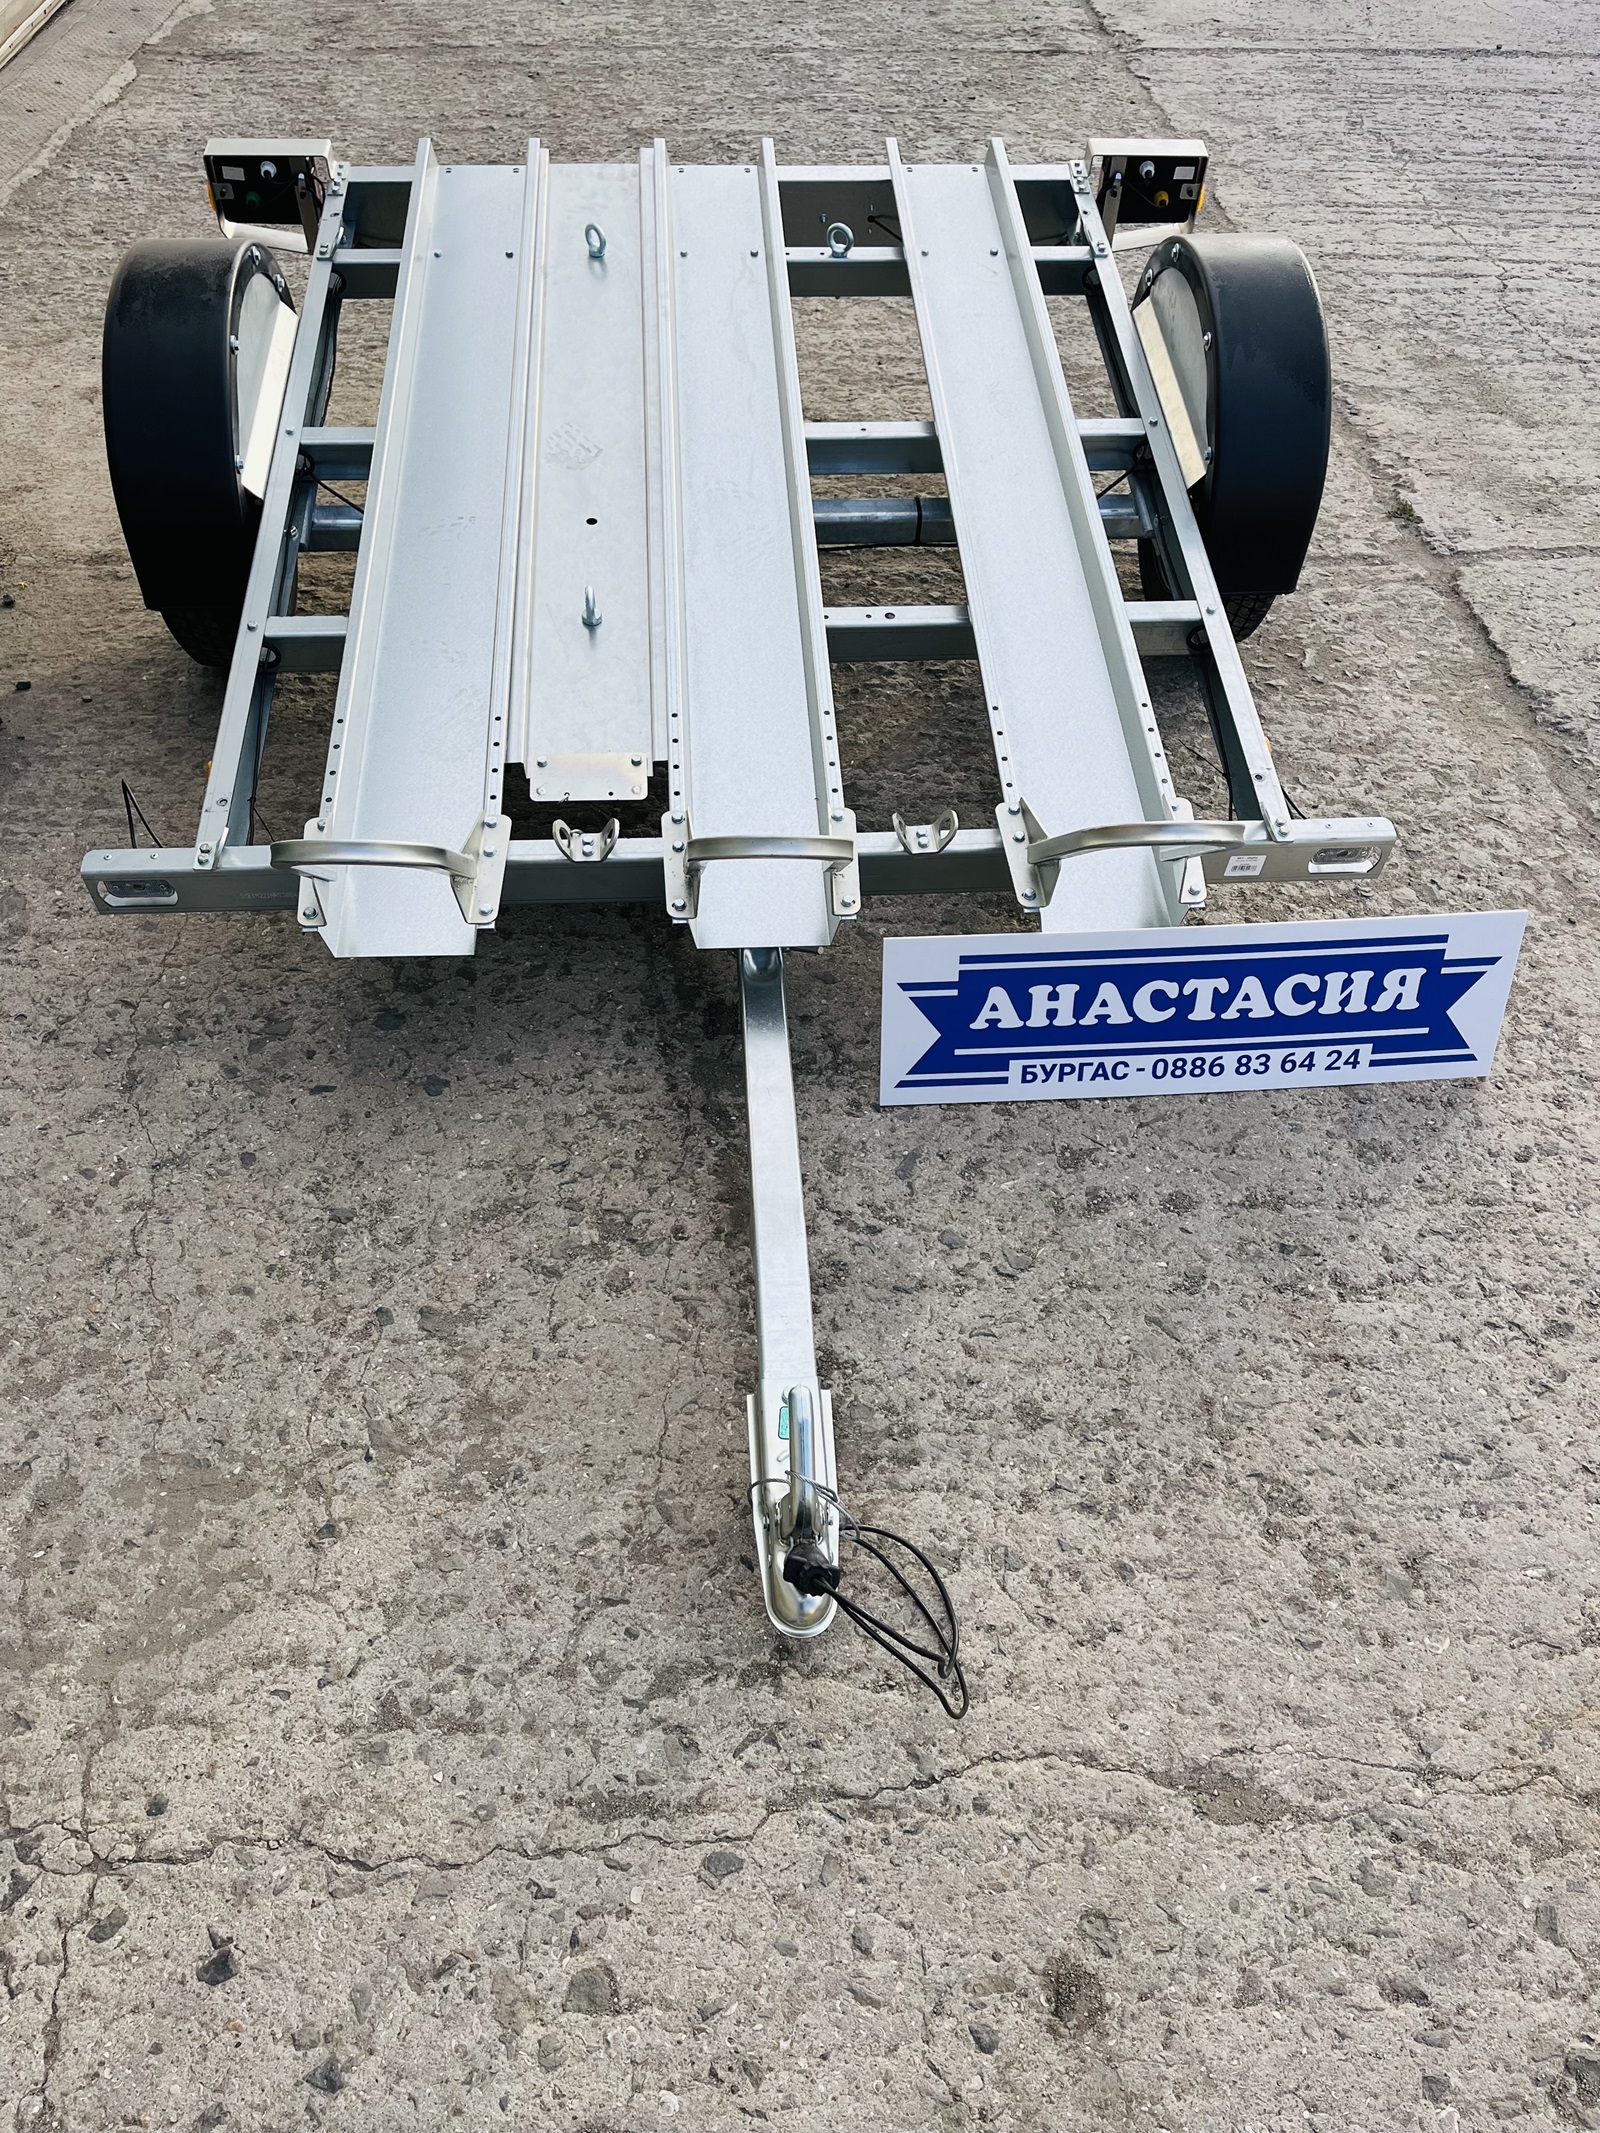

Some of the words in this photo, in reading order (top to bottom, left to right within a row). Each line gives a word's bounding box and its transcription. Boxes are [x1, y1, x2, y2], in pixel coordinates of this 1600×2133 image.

[969, 966, 1428, 1030] АНАСТАСИЯ
[1020, 1060, 1130, 1084] БУРГАС
[1234, 1053, 1271, 1076] 83
[1280, 1051, 1316, 1074] 64
[1324, 1048, 1361, 1071] 24
